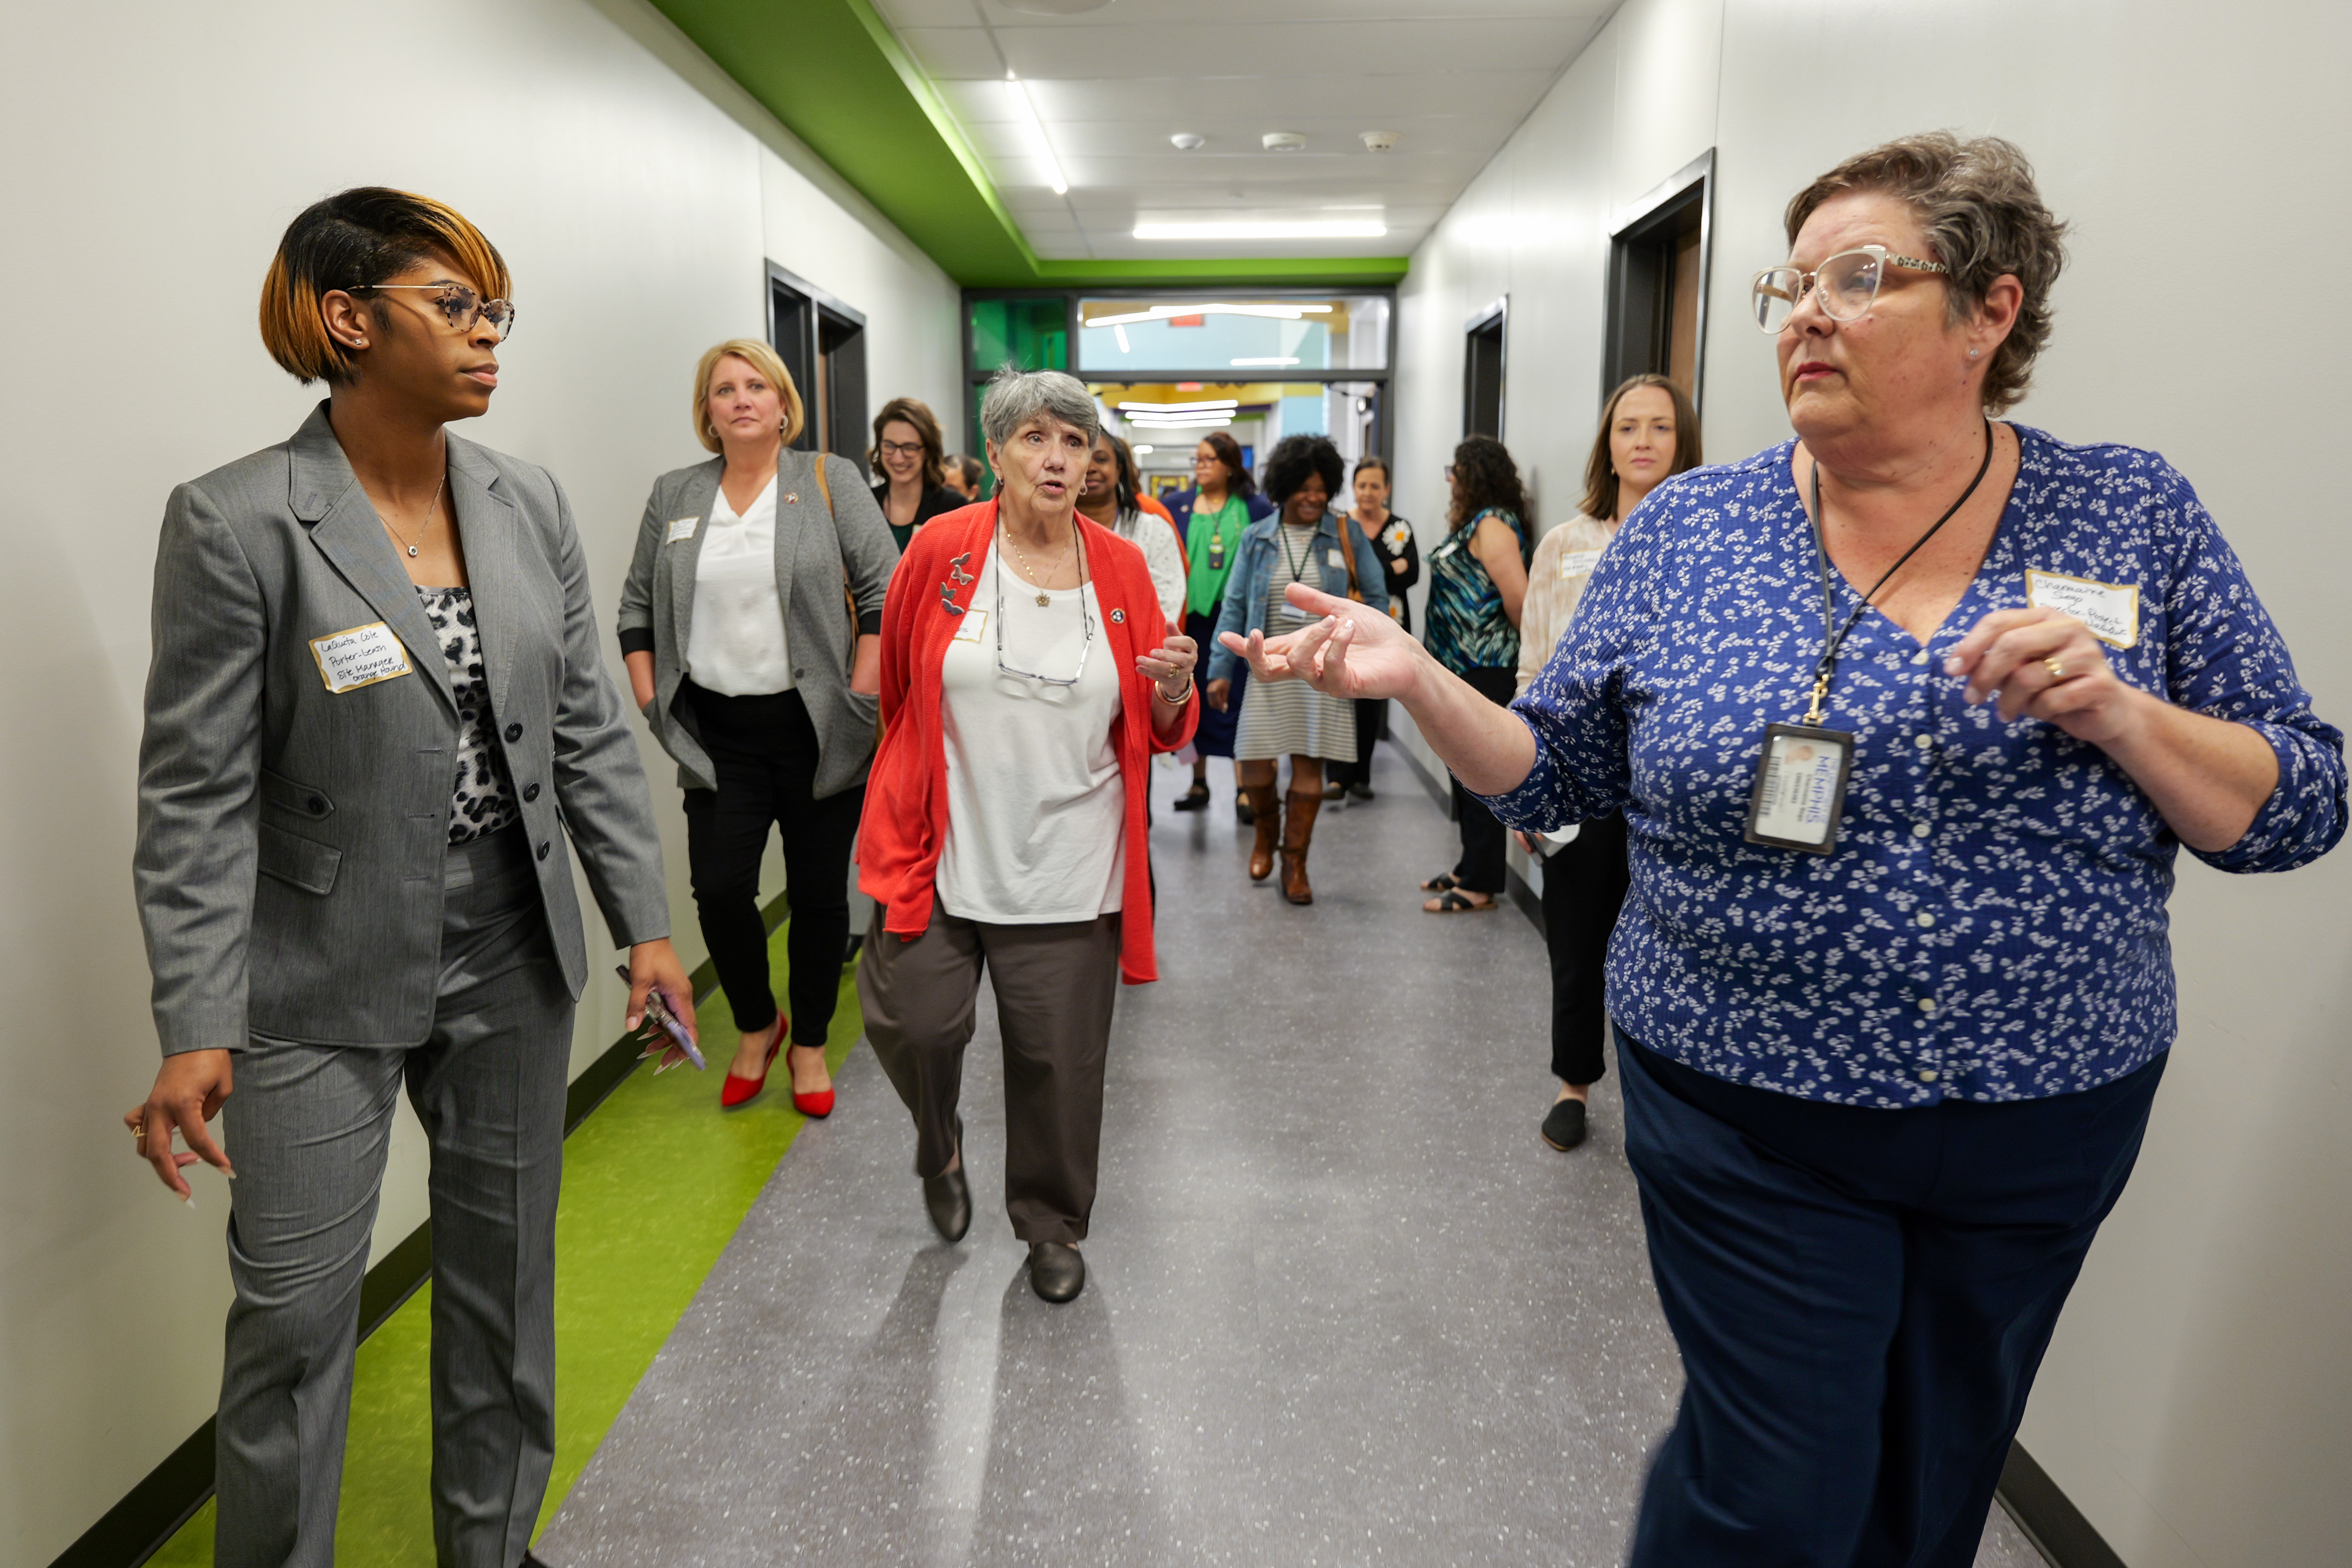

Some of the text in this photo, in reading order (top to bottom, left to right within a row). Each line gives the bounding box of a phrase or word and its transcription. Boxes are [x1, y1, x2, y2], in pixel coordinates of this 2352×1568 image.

[321, 630, 379, 652] LaQuita Cole
[337, 668, 354, 680] Site
[1805, 756, 1830, 824] MEMPHIS
